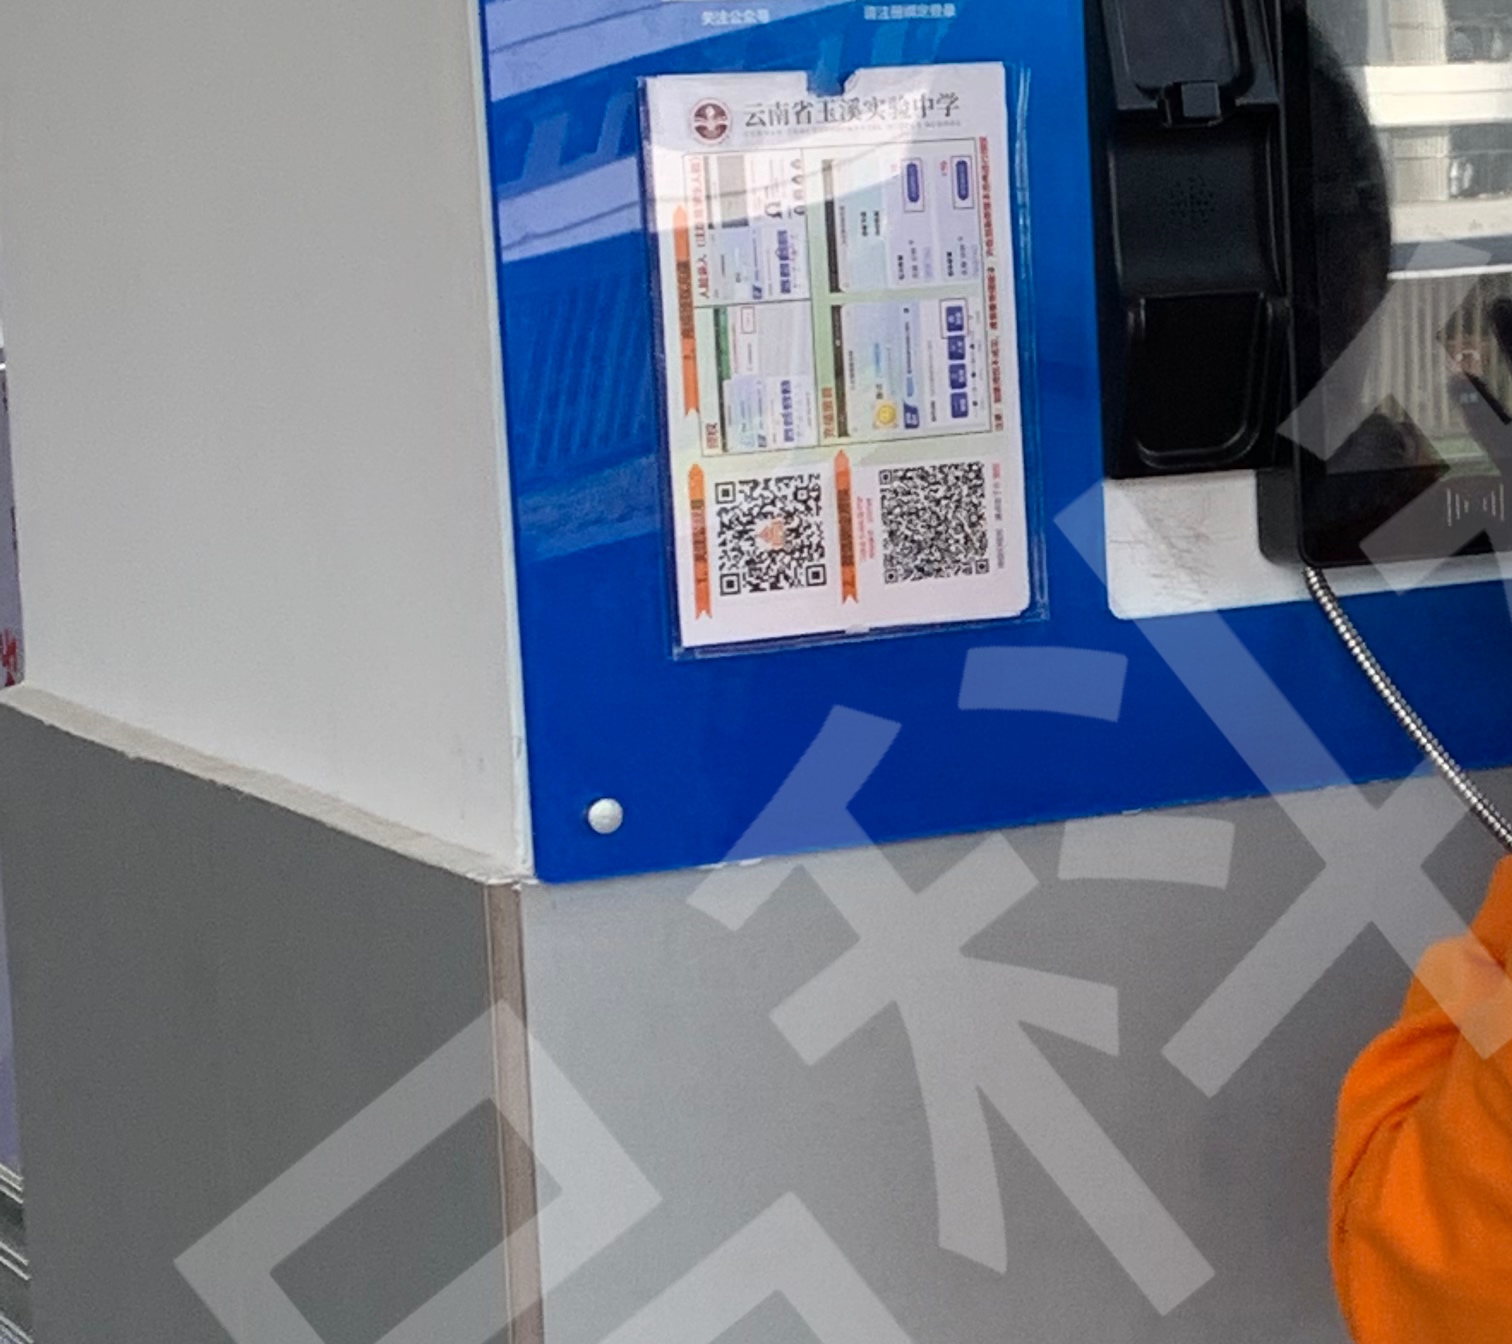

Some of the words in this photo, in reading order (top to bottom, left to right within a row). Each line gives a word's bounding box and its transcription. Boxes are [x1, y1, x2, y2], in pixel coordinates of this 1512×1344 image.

[743, 91, 960, 128] 云南省玉溪实验中学
